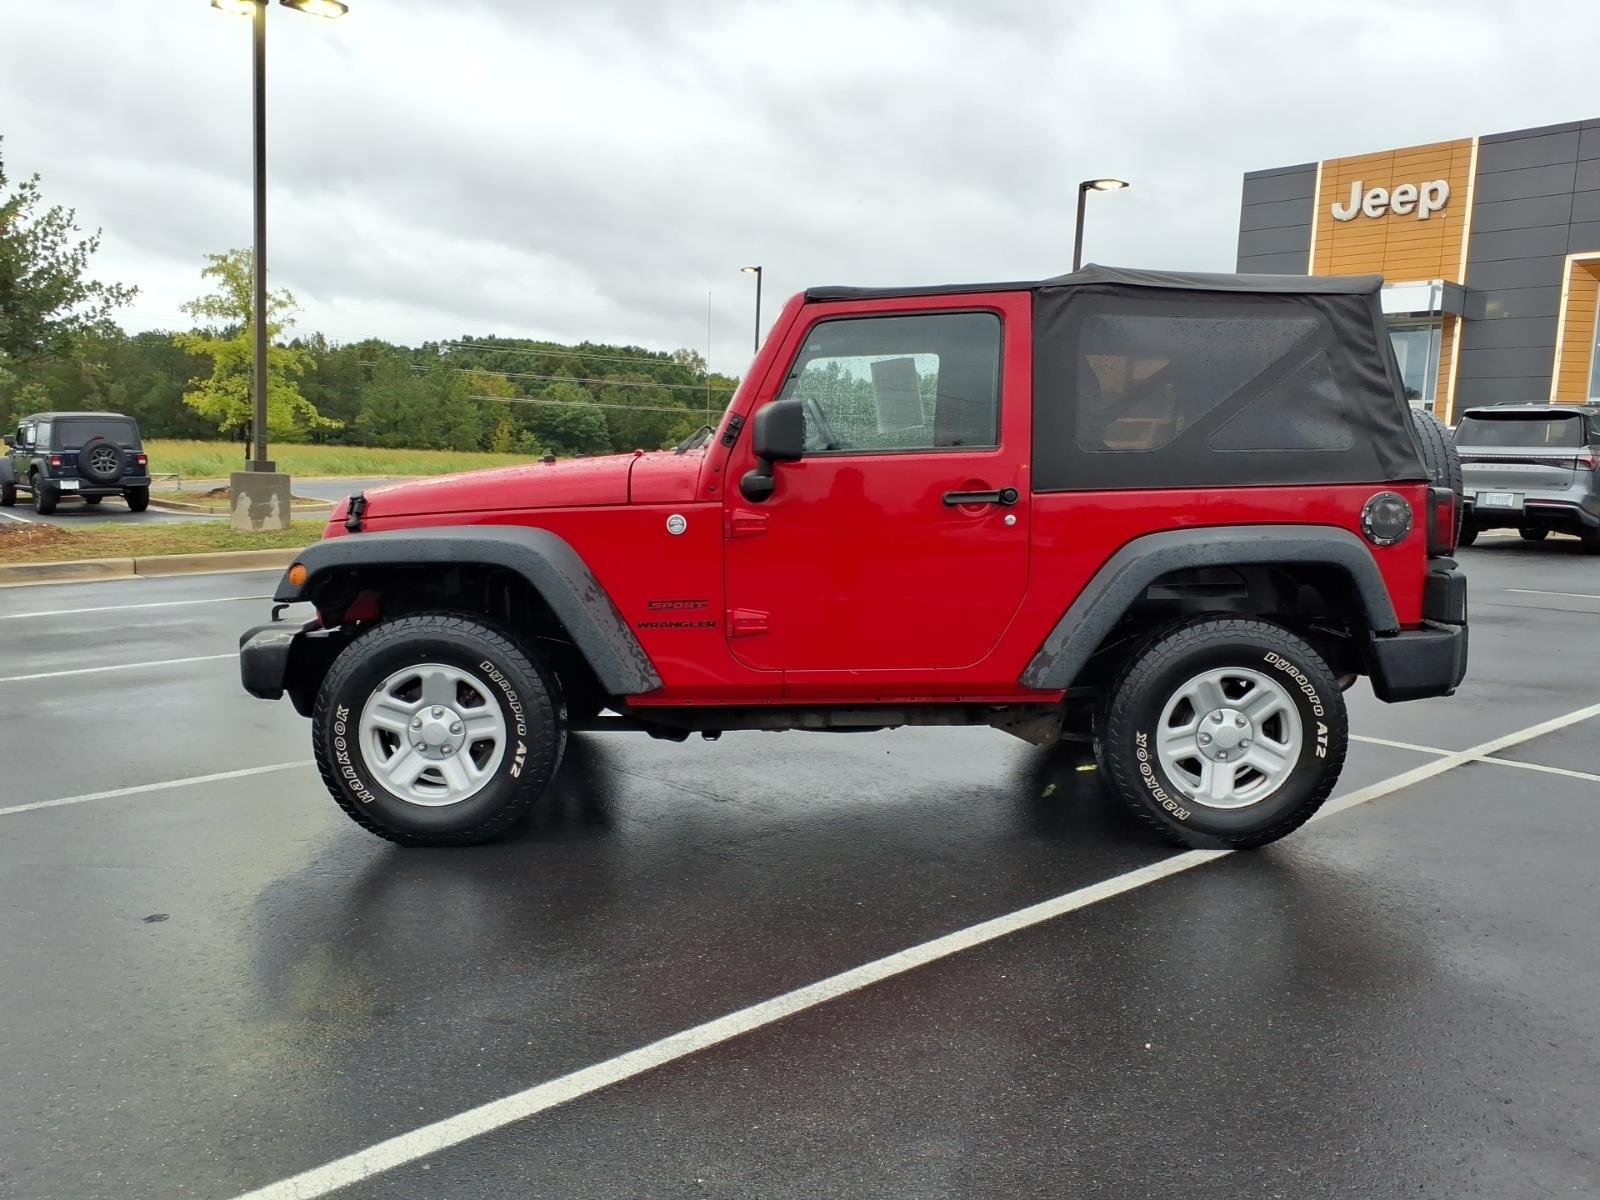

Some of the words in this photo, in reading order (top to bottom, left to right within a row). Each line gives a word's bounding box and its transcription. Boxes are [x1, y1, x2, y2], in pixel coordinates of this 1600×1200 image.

[1331, 180, 1449, 221] Jeep
[637, 621, 716, 629] WRANGLER
[651, 601, 708, 609] SPORT
[479, 660, 528, 737] Dynapro
[509, 740, 529, 779] AT2
[1263, 651, 1325, 717] Dynapro
[1314, 721, 1329, 760] AT2
